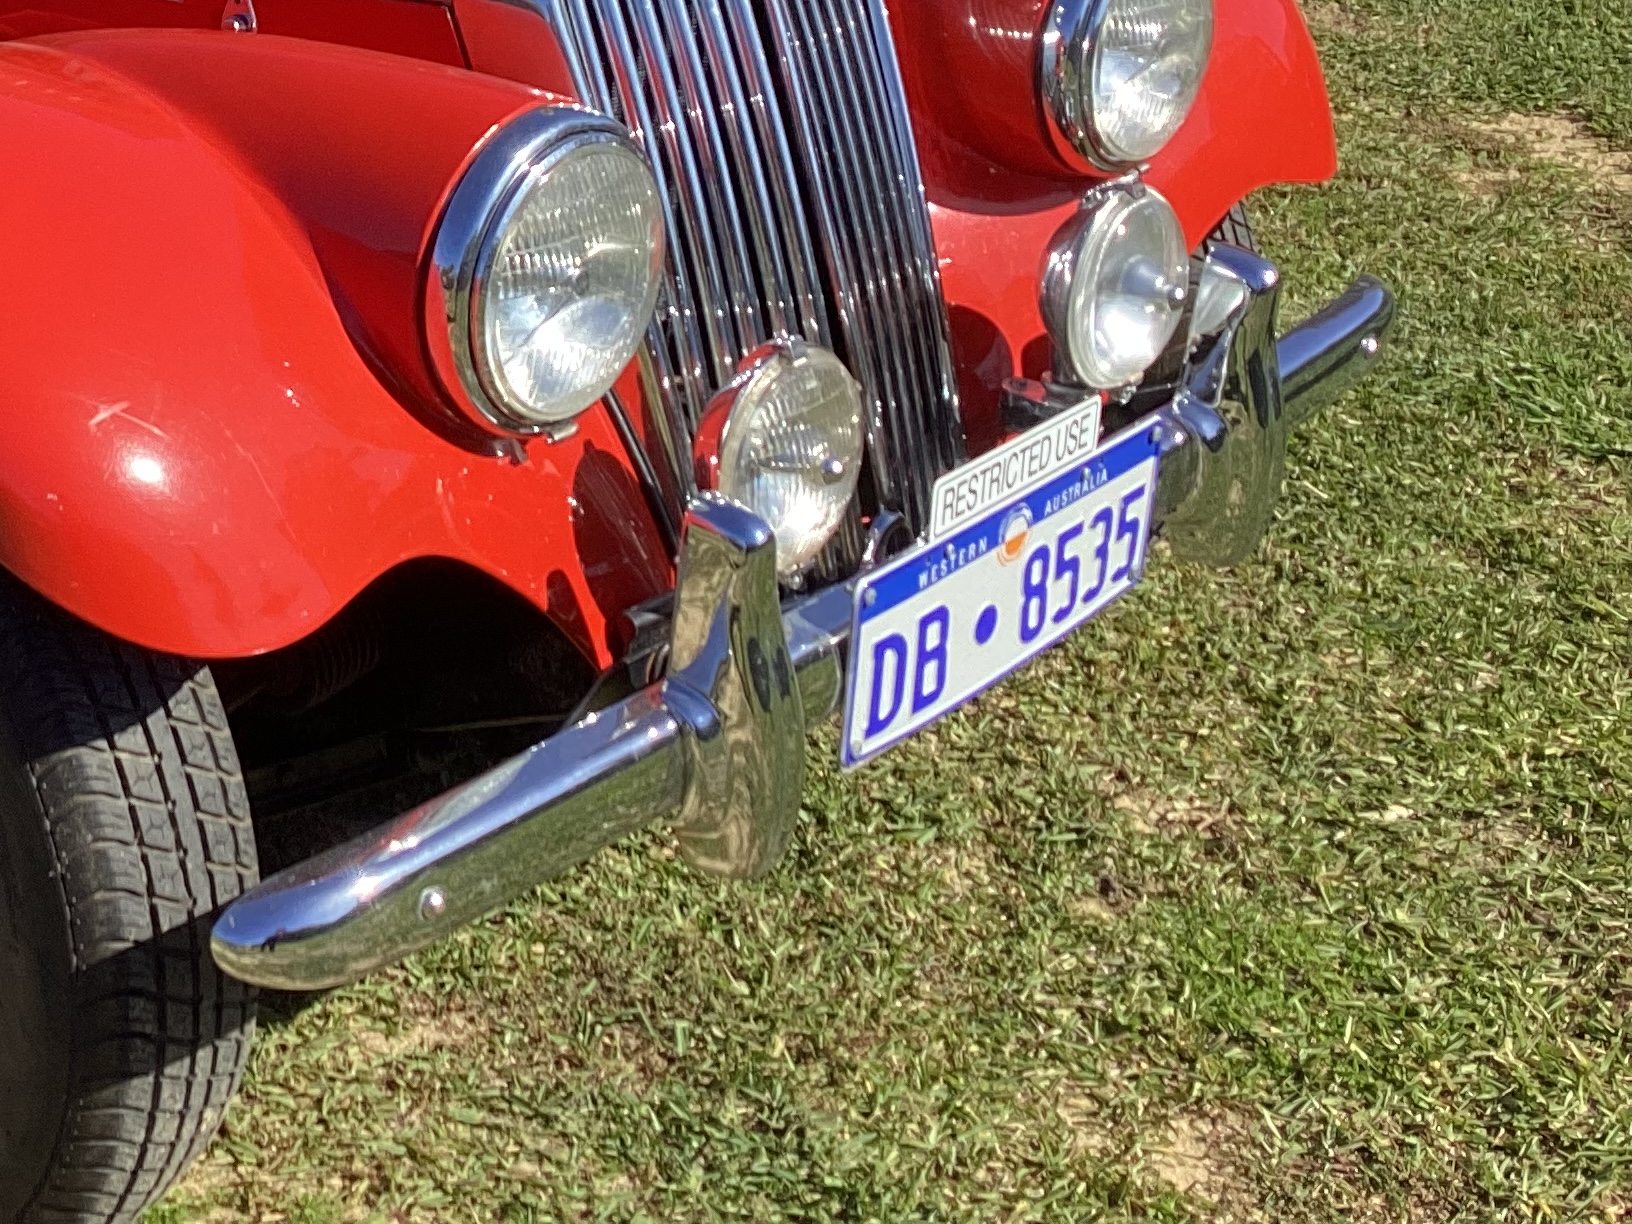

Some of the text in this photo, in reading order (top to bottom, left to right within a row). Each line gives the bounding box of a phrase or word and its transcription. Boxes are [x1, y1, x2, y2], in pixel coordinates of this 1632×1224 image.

[918, 467, 1108, 589] WESTERN AUSTRALIA
[942, 413, 1091, 526] RESTRICTED USE
[865, 486, 1146, 739] DB 8535
